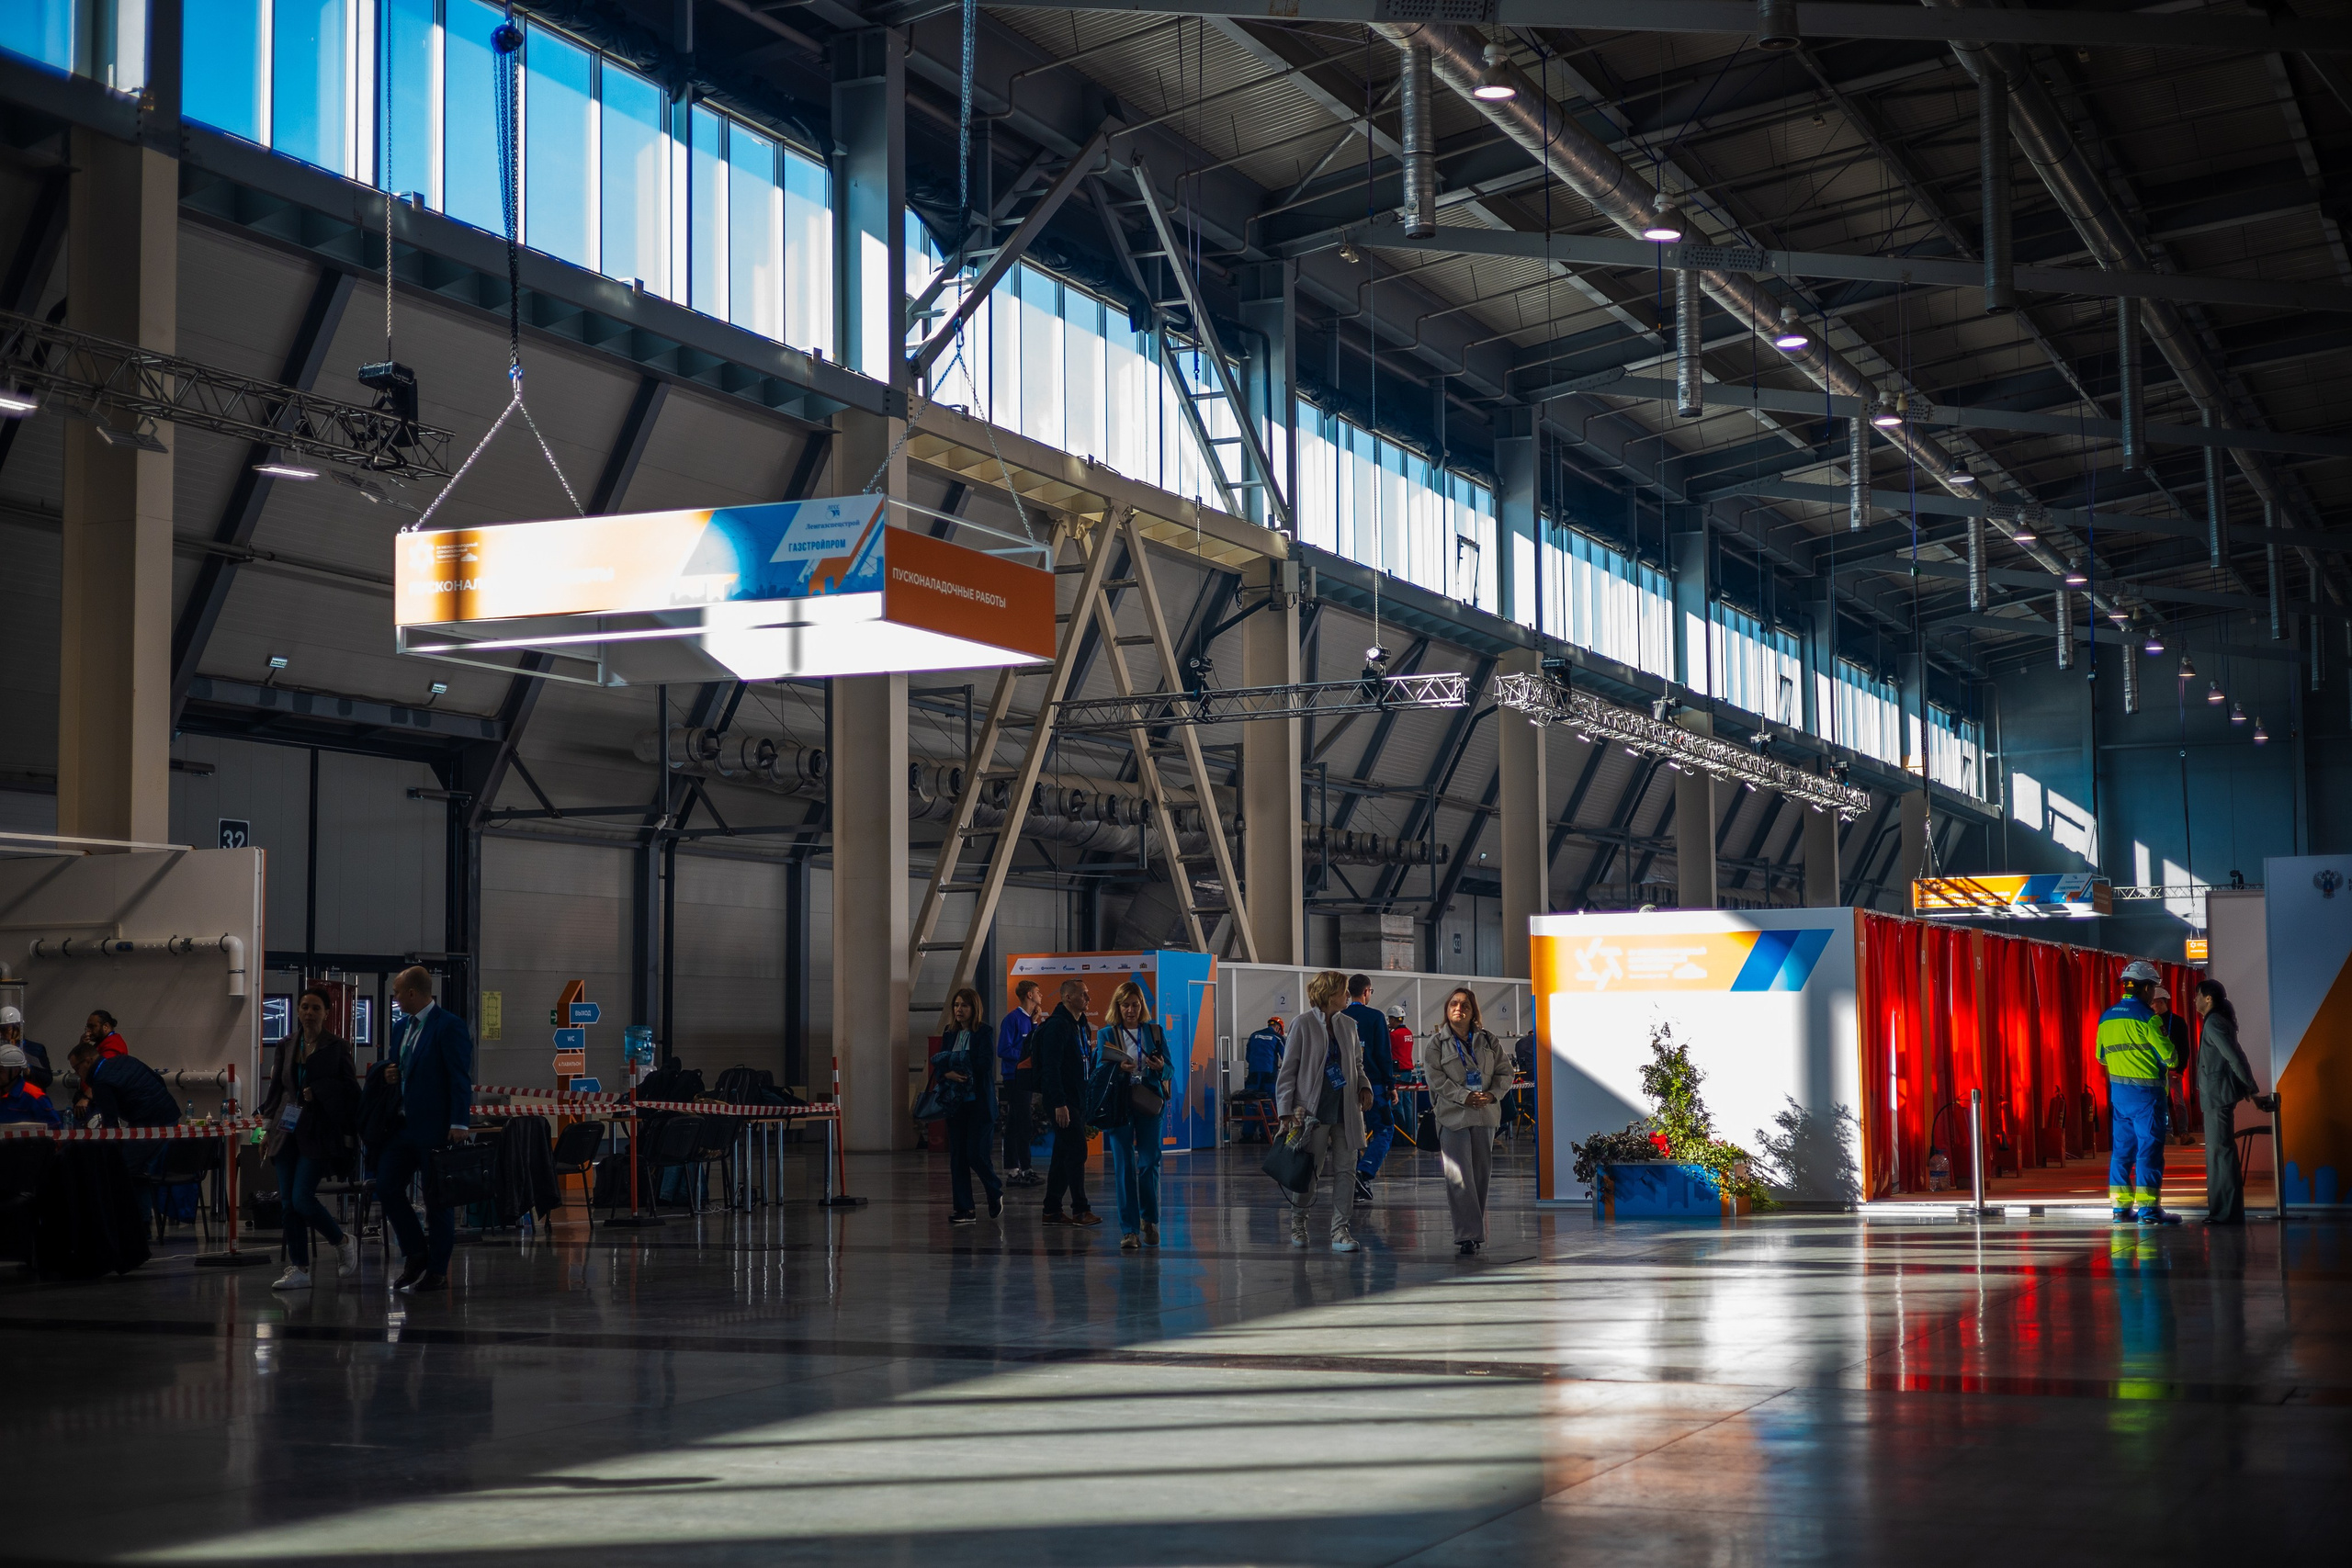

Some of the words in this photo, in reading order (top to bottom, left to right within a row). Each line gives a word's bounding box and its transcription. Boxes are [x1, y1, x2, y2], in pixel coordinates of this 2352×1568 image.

[806, 519, 861, 530] Ленгазспецстрой
[788, 539, 846, 552] ГАЗСТРОЙПРОМ
[892, 567, 974, 600] ПУСКОНАЛАДОЧНЫЕ
[976, 590, 1006, 608] РАБОТЫ
[222, 829, 245, 849] 32
[1976, 956, 1982, 970] 19
[1280, 996, 1286, 1005] 2
[1401, 999, 1407, 1008] 4
[1501, 1005, 1507, 1013] 6
